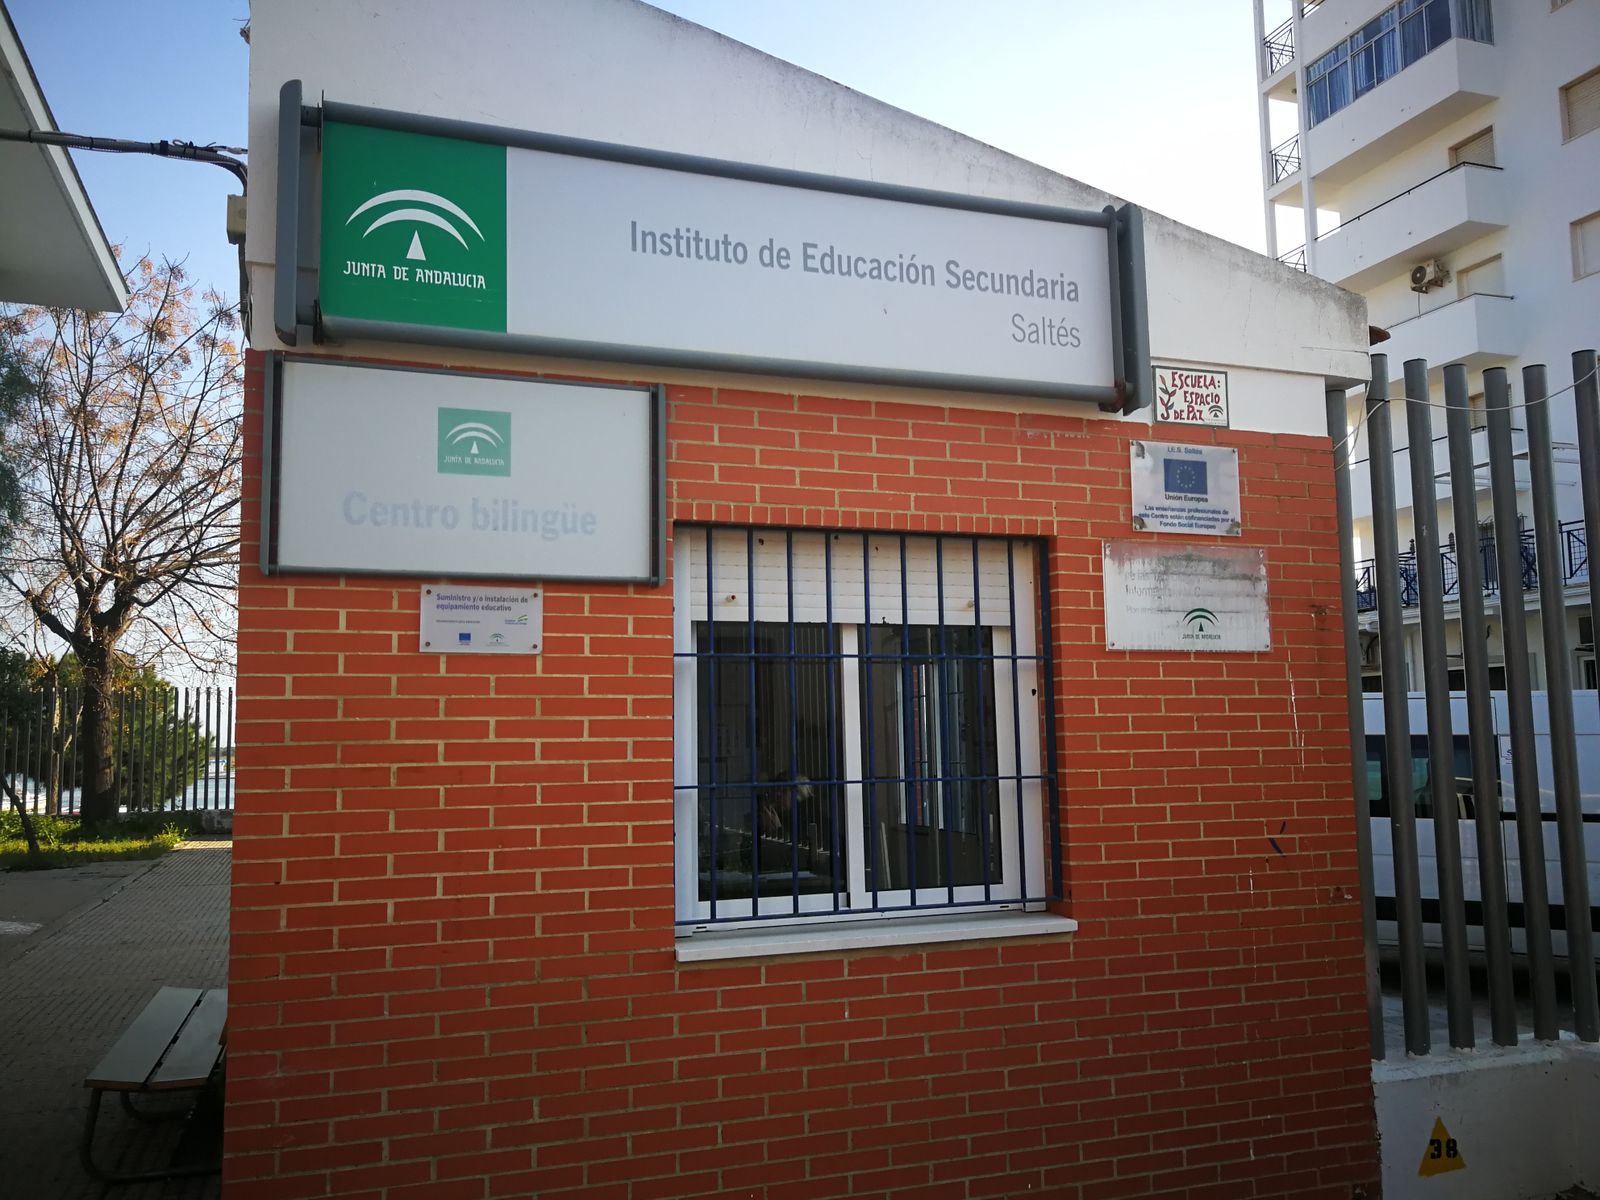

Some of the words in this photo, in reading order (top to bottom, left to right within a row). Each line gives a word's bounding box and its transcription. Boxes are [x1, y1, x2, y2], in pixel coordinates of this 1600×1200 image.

[630, 220, 748, 265] Instituto
[758, 238, 791, 269] de
[802, 241, 936, 287] Educación
[945, 259, 1080, 302] Secundaria
[343, 260, 386, 279] JUNTA
[393, 266, 409, 281] DE
[415, 268, 486, 289] ANDALUCIA
[1011, 312, 1082, 349] Saltés
[1184, 391, 1220, 406] ESPACIO
[1174, 409, 1185, 420] DE
[1186, 404, 1205, 422] PAZ
[443, 455, 463, 464] JUNTA
[464, 456, 472, 464] DE
[1184, 495, 1208, 503] Europea
[342, 489, 460, 531] Centro
[471, 497, 598, 542] bilingüe
[1150, 512, 1169, 520] Centro
[1159, 520, 1177, 528] Fondo
[1177, 521, 1194, 529] Social
[1194, 522, 1217, 531] Europeo
[436, 593, 471, 602] Suministro
[520, 596, 528, 604] de
[436, 602, 480, 612] equipamiento
[481, 604, 512, 612] educativo
[1429, 1138, 1458, 1160] 38
